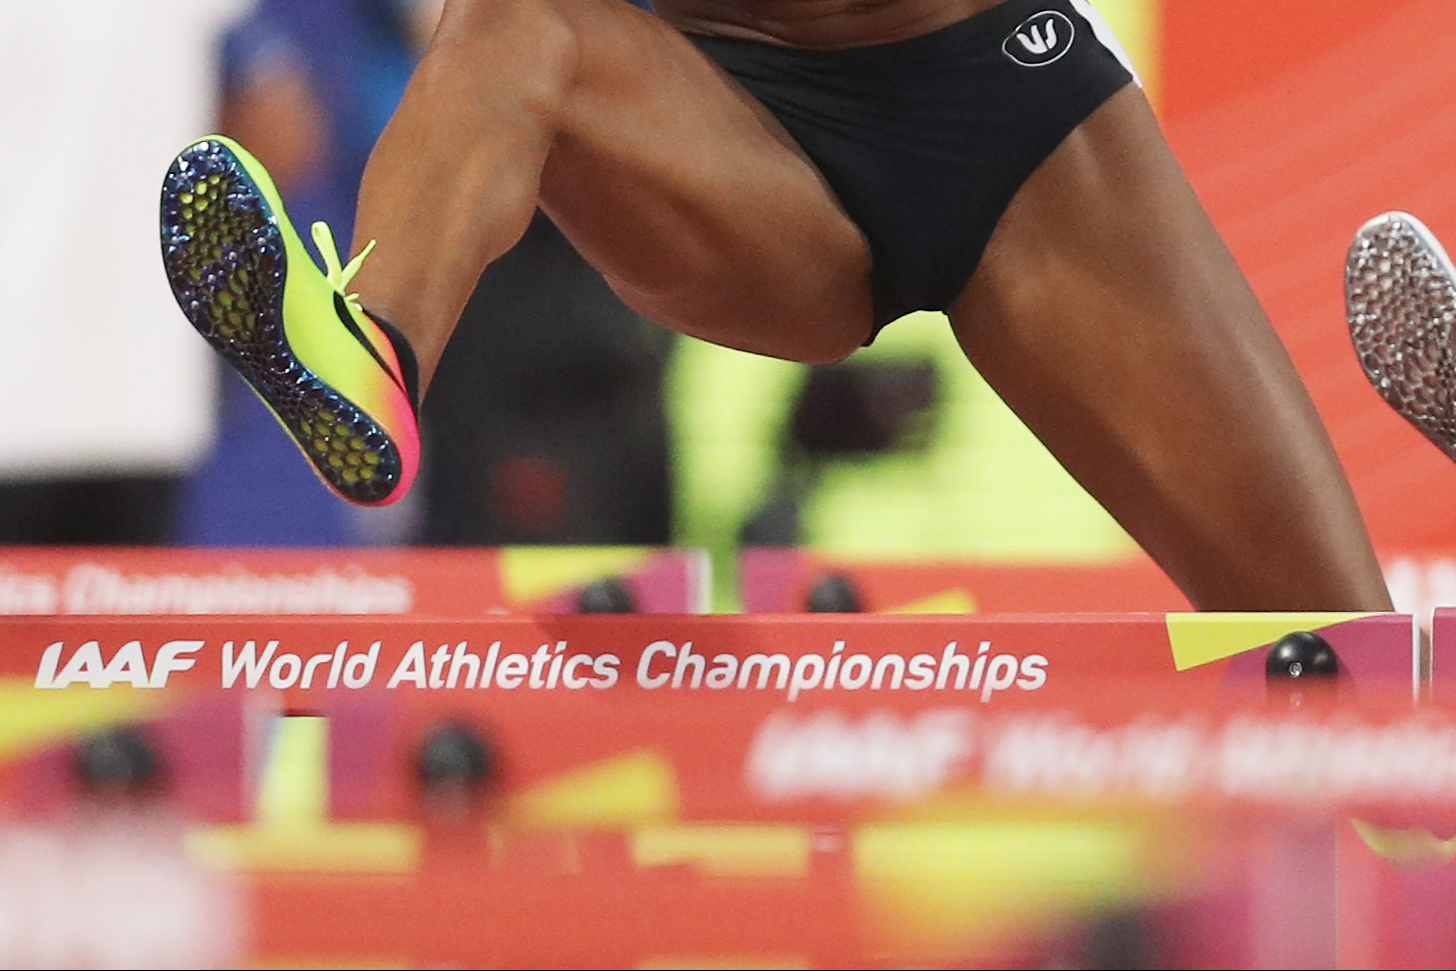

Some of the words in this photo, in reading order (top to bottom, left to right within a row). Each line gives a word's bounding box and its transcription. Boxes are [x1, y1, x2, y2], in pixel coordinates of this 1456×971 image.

[35, 640, 205, 689] IAAF
[222, 640, 382, 690] World
[386, 639, 620, 690] Athletics
[636, 639, 1050, 703] Championships
